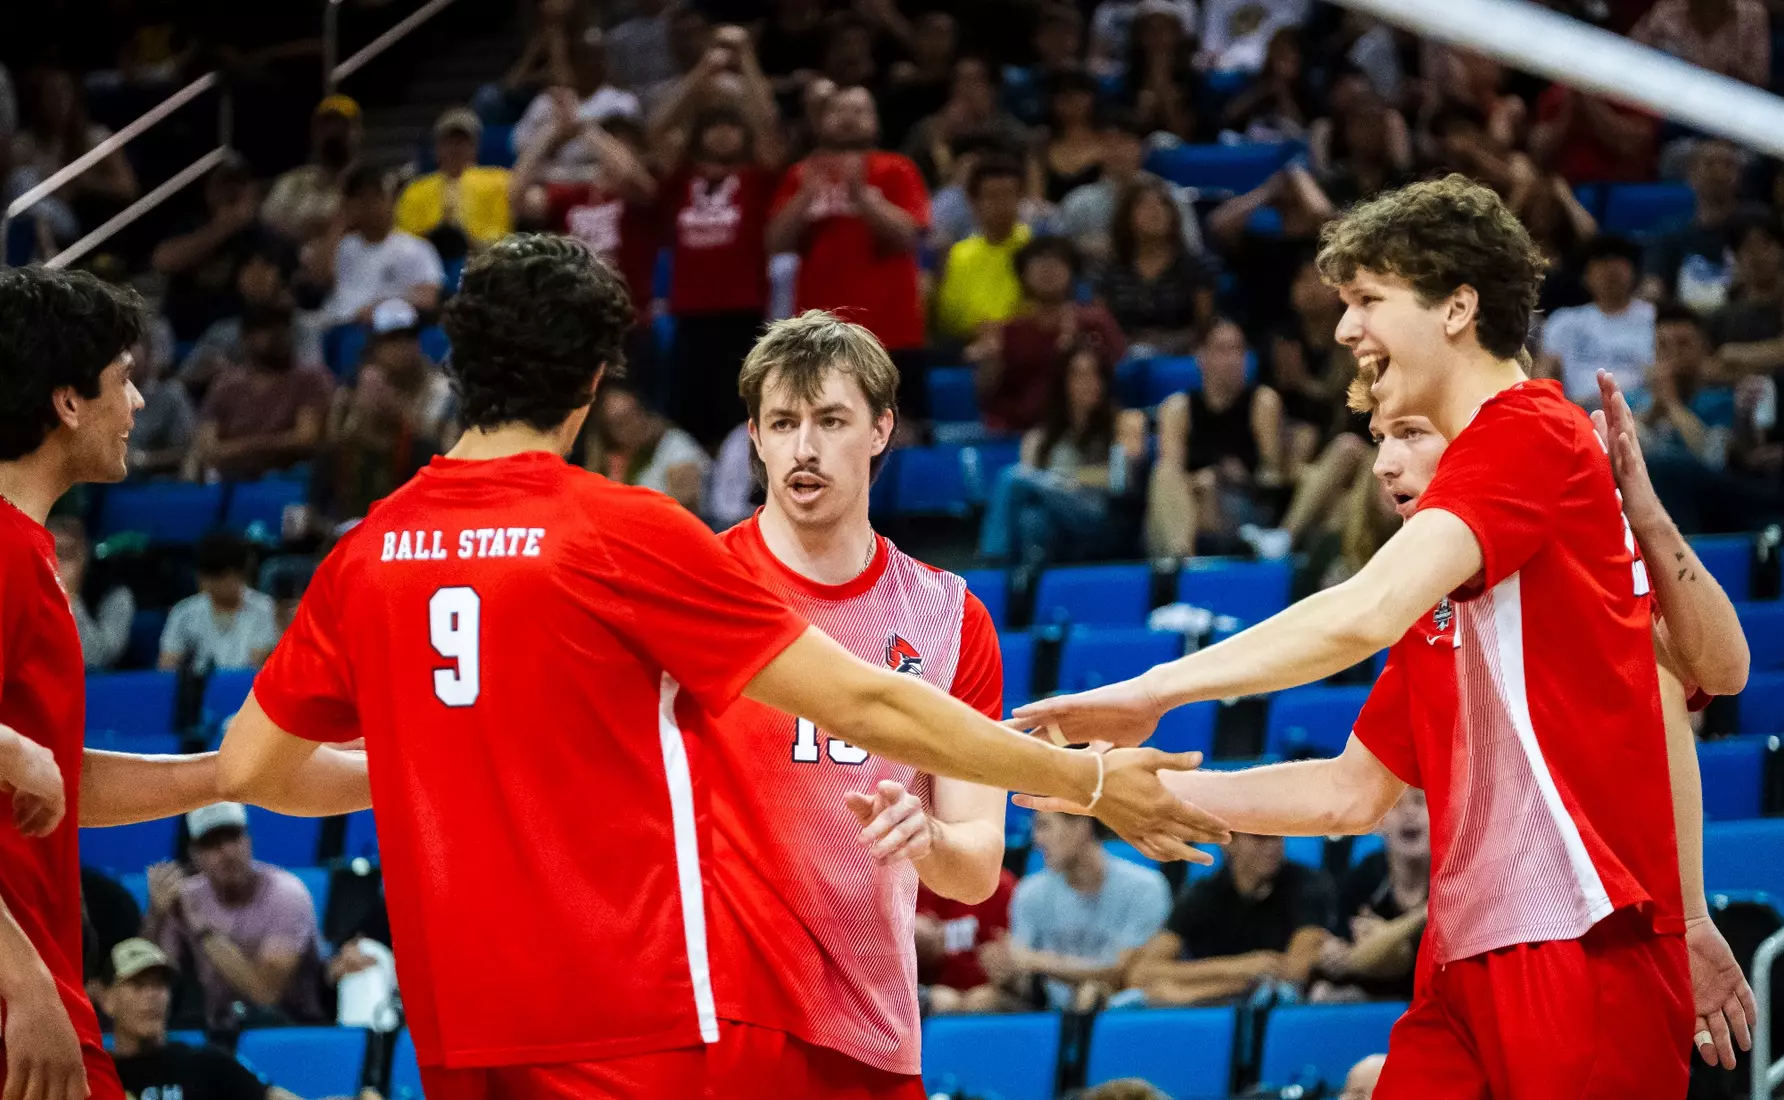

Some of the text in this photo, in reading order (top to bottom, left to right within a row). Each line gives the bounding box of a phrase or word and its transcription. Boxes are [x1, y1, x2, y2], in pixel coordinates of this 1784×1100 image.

[381, 527, 546, 562] BALL STATE
[429, 585, 481, 708] 9
